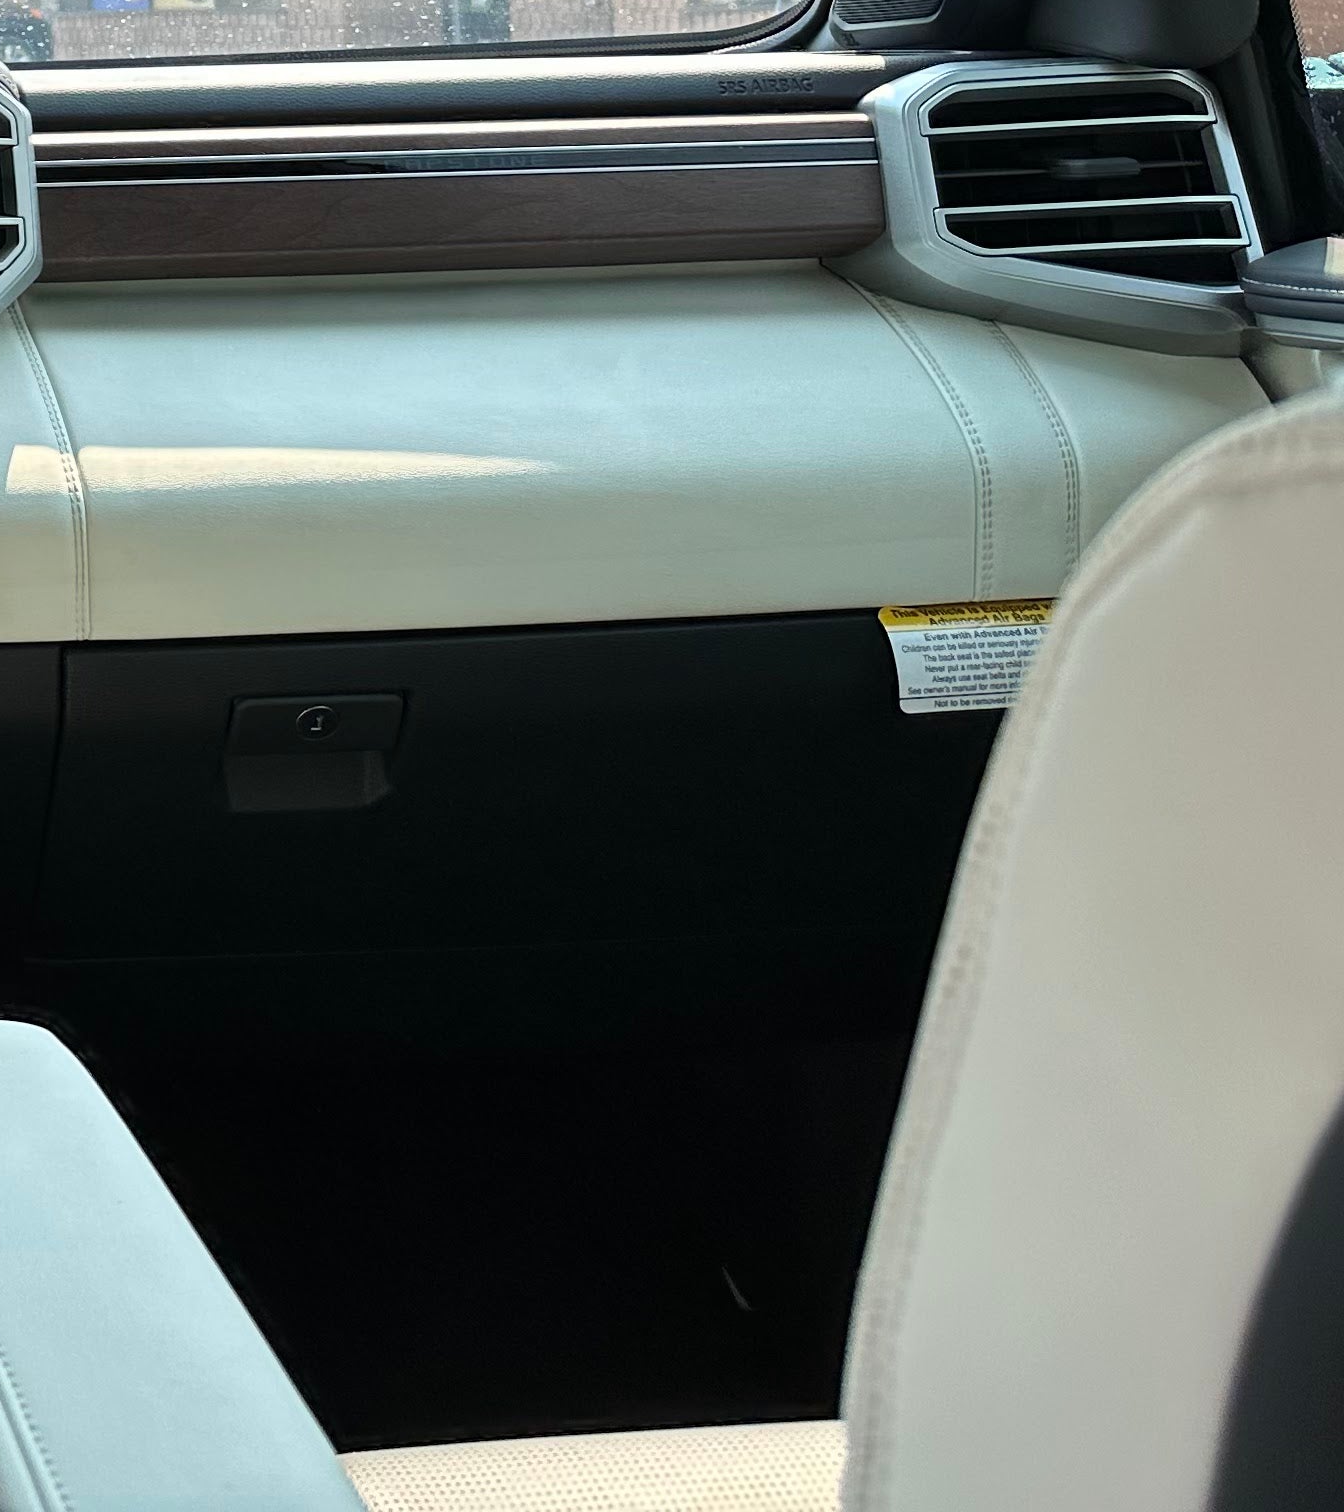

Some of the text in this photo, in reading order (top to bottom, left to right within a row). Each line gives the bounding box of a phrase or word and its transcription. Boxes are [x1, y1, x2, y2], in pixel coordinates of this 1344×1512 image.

[718, 77, 814, 95] SRS AIRBAG
[890, 609, 917, 619] This
[920, 607, 965, 618] Vehicle
[980, 602, 1041, 615] Equipped
[929, 614, 989, 626] Advanced
[1015, 612, 1046, 624] Bags
[924, 632, 949, 642] Even
[951, 630, 972, 640] with
[973, 628, 1022, 639] Advanced
[1024, 627, 1038, 636] Air
[902, 644, 932, 653] Children
[948, 642, 957, 651] be
[923, 654, 937, 662] The
[938, 653, 955, 662] back
[925, 665, 945, 673] Never
[1006, 660, 1022, 668] child
[932, 675, 957, 683] Always
[1007, 670, 1021, 678] and
[908, 686, 921, 695] See
[923, 685, 951, 694] owner's
[952, 684, 977, 693] manual
[979, 683, 989, 691] for
[934, 700, 948, 708] Not
[960, 697, 971, 706] be
[972, 697, 1006, 705] removed
